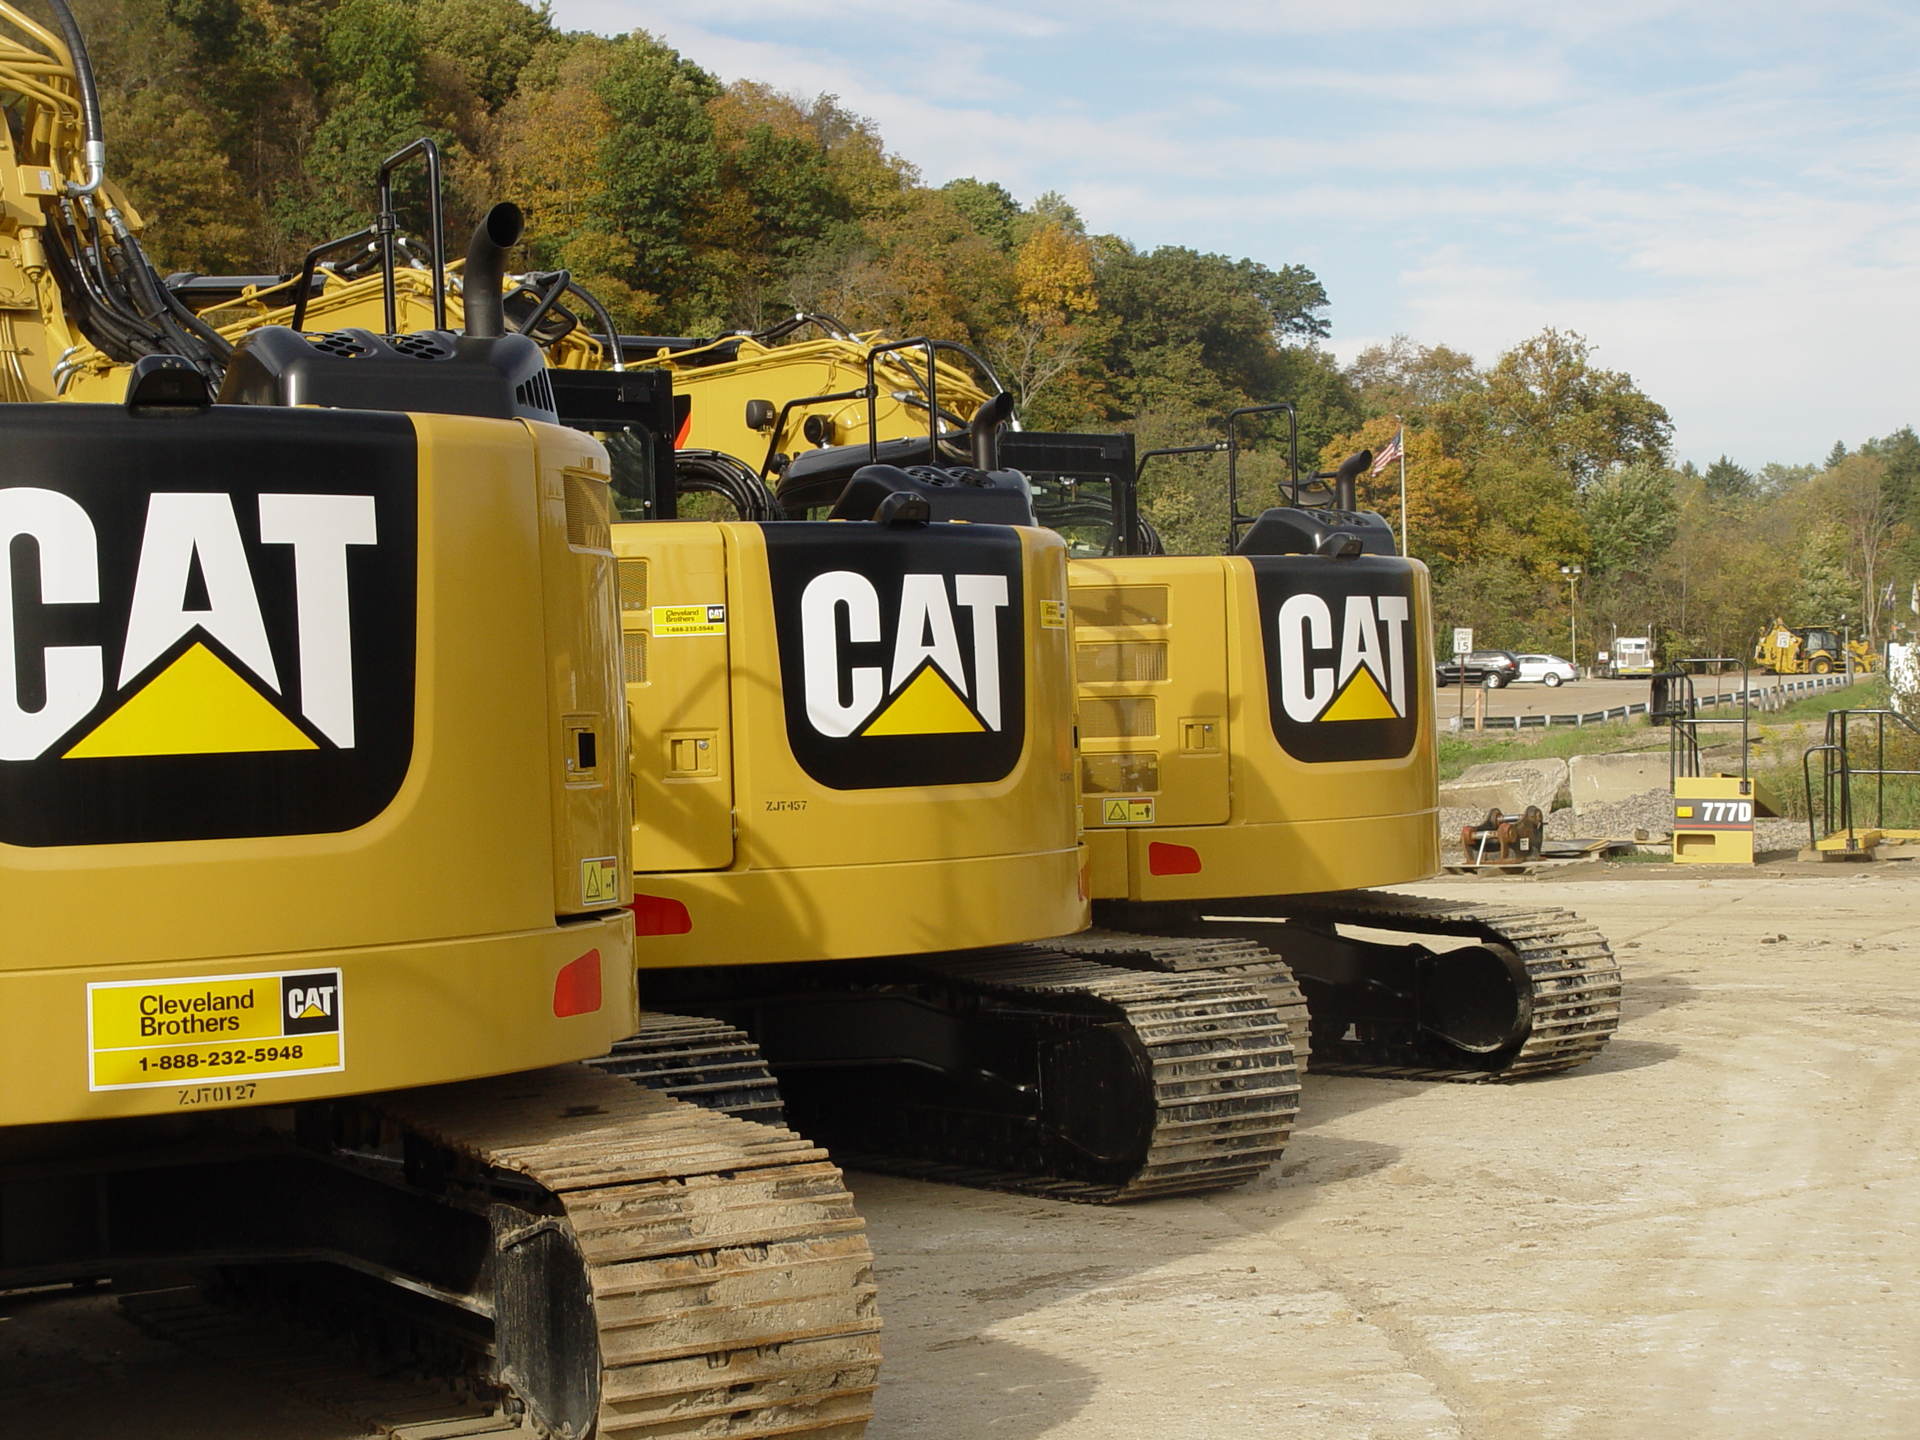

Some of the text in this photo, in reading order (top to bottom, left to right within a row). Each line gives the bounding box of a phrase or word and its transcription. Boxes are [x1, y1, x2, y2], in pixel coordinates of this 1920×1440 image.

[0, 487, 378, 762] CAT
[665, 609, 700, 617] Cleveland
[708, 609, 724, 620] CAT
[800, 571, 1009, 738] CAT
[1457, 641, 1469, 651] 15
[1278, 593, 1409, 723] CAT
[765, 800, 808, 811] ZJT457
[1701, 802, 1752, 822] 777D
[139, 989, 255, 1016] Cleveland
[288, 986, 334, 1019] CAT
[140, 1014, 240, 1037] Brothers
[138, 1045, 304, 1072] 1-888-232-5948
[178, 1083, 257, 1106] ZJT0127
